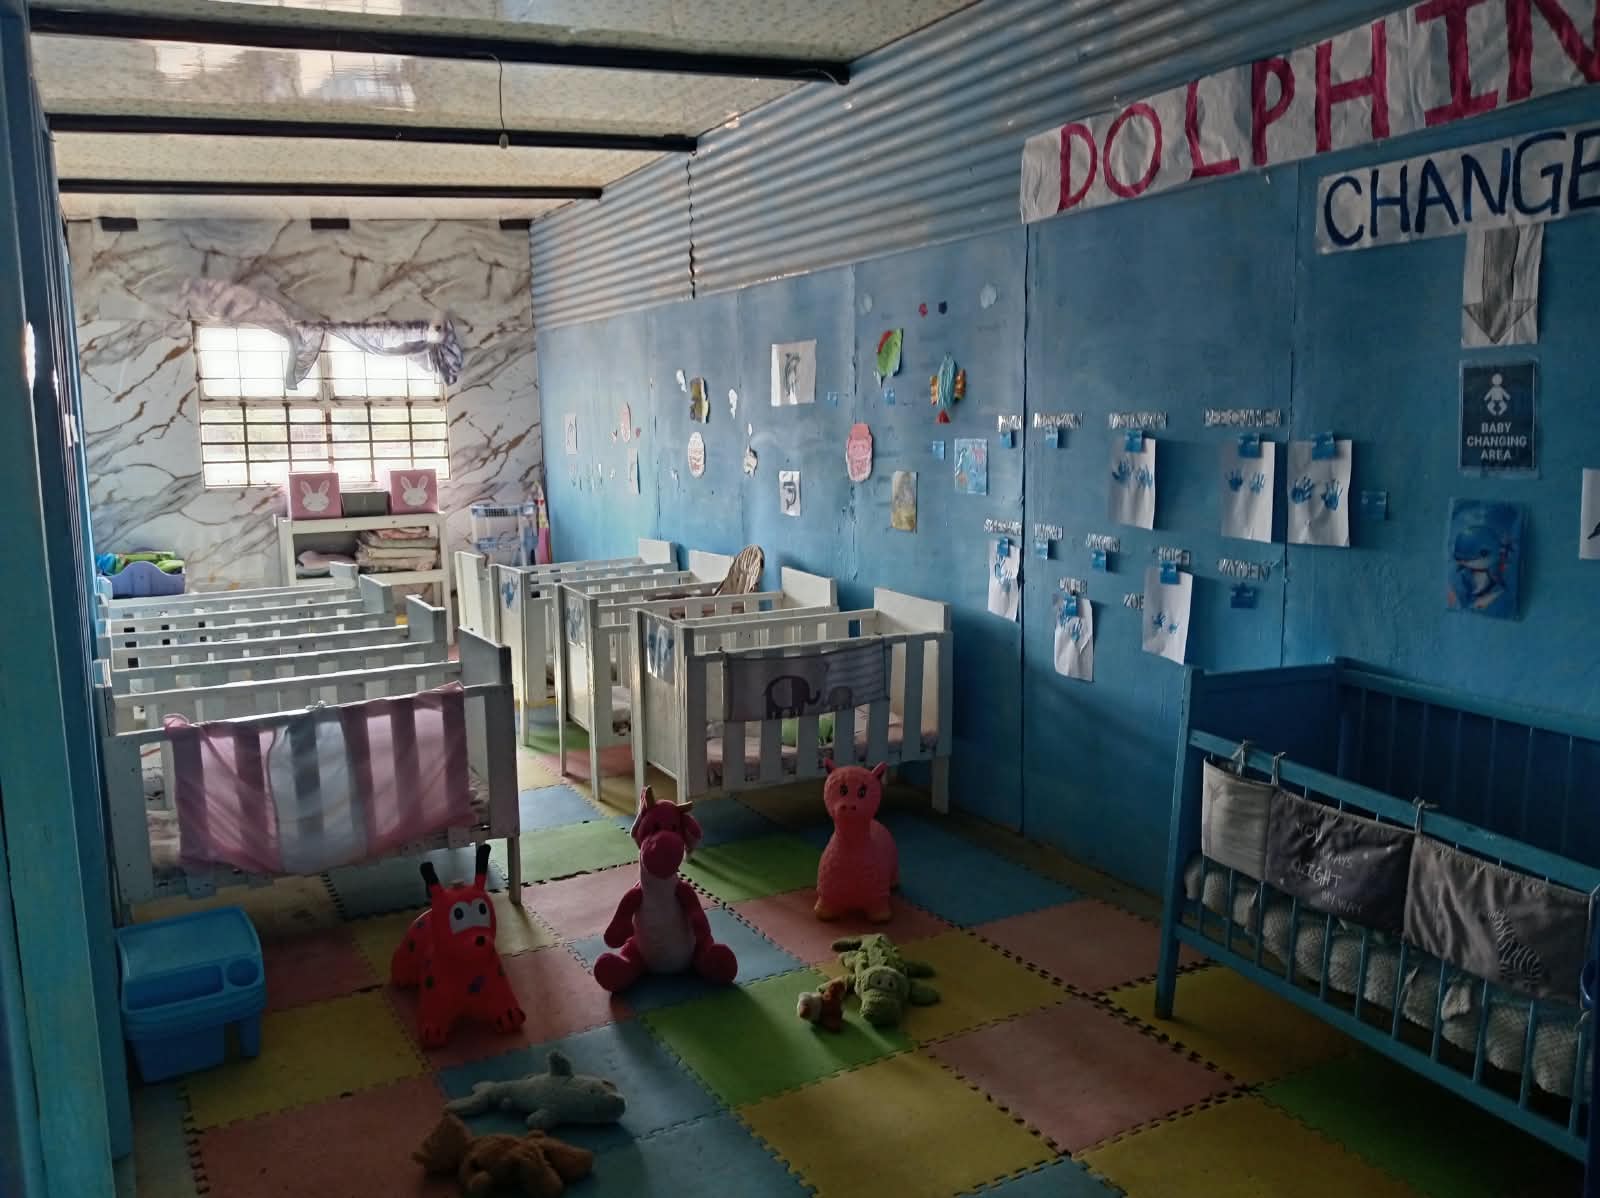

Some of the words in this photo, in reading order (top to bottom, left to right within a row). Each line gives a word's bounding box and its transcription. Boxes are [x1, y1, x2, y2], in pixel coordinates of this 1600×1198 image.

[1057, 0, 1600, 214] DOLPHIN
[1481, 422, 1512, 433] BABY
[1466, 435, 1528, 448] CHANGING
[1480, 449, 1511, 461] AREA
